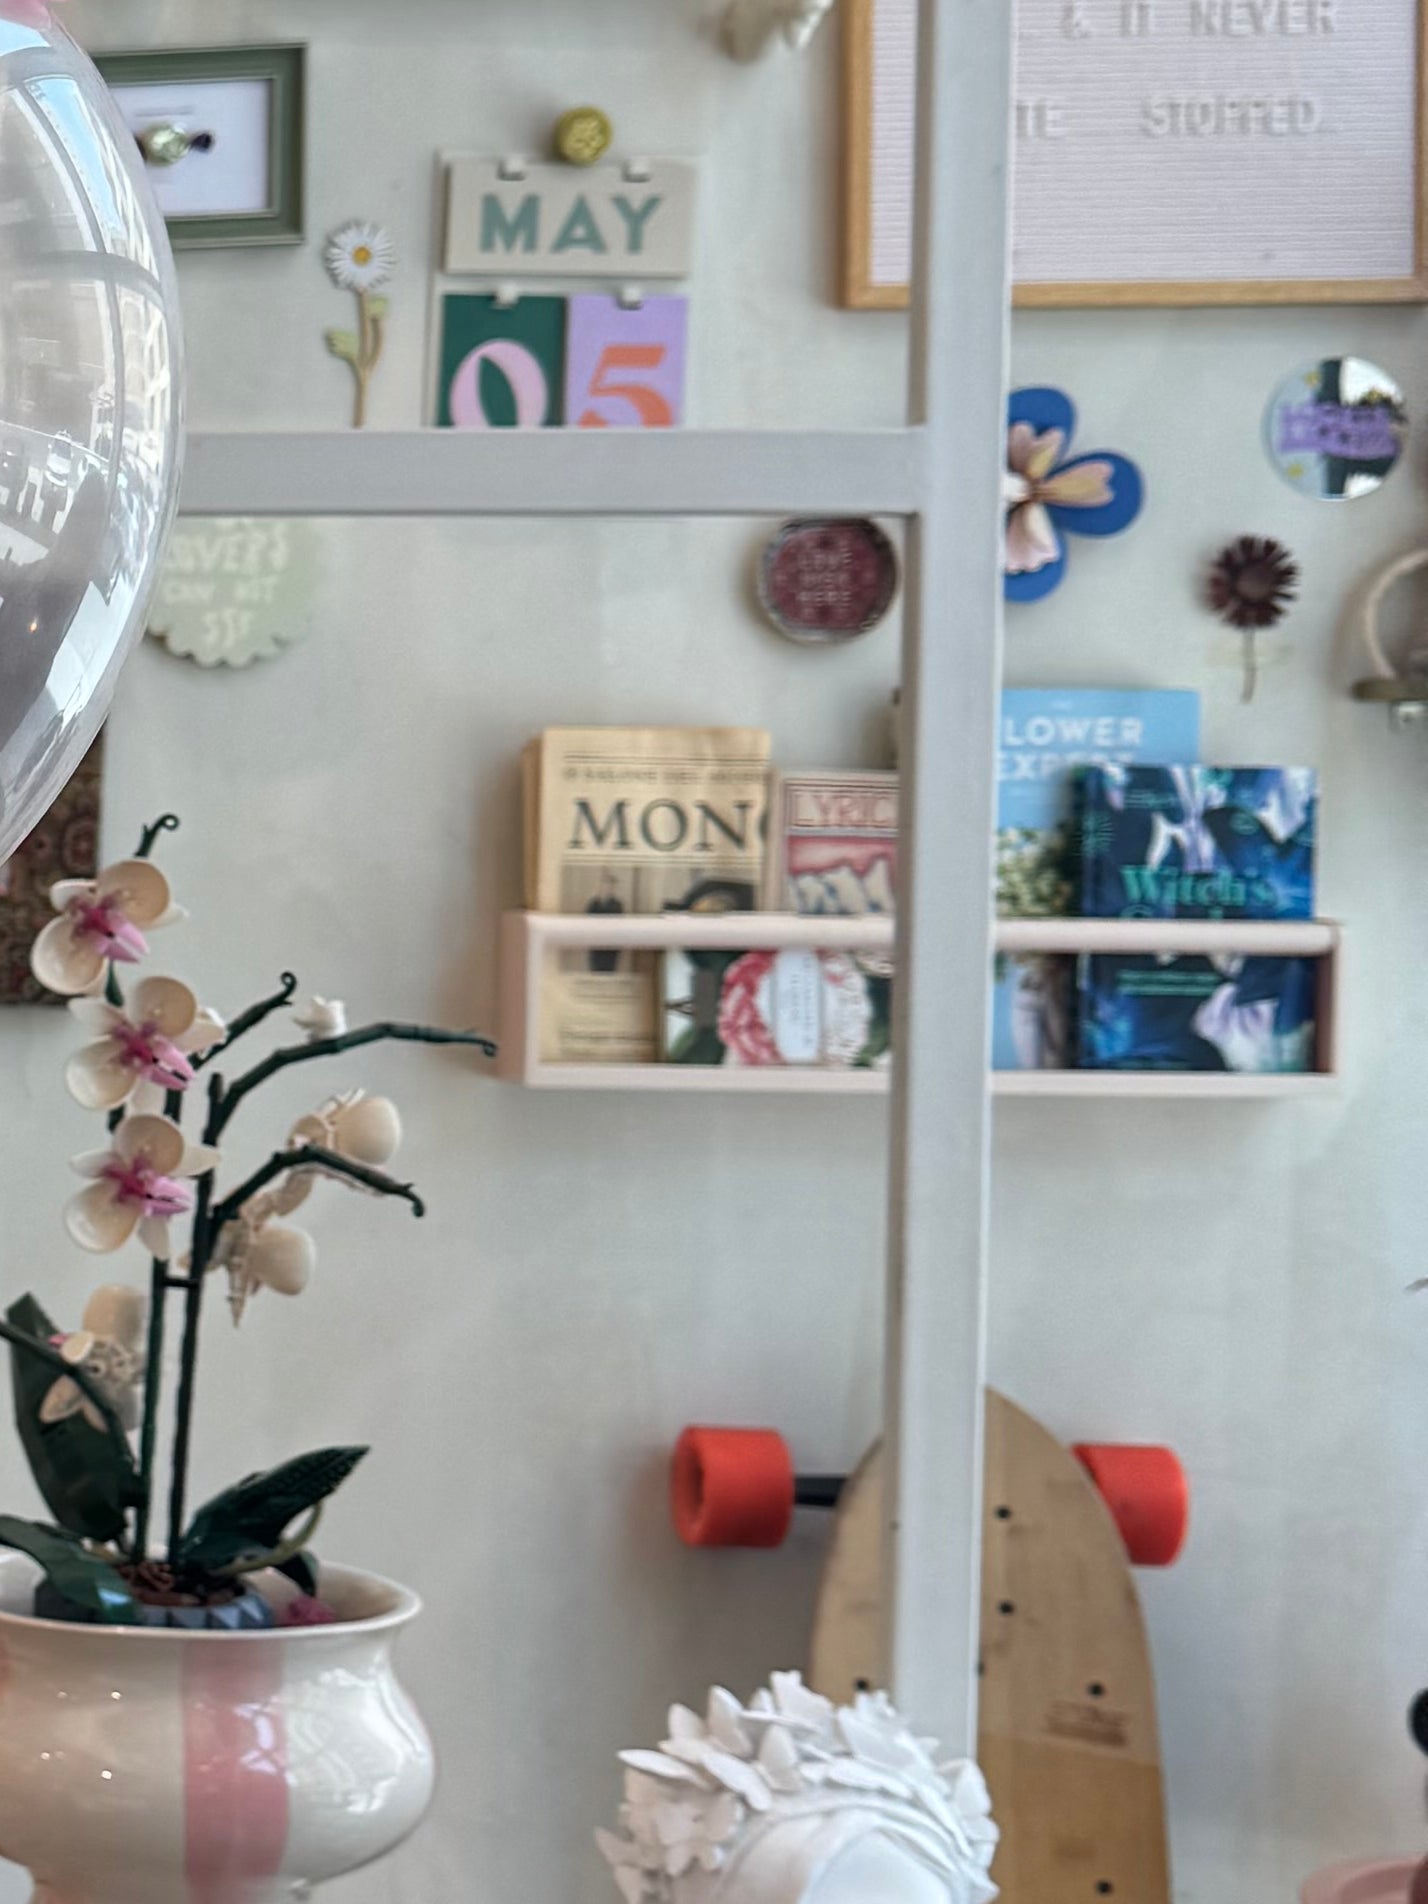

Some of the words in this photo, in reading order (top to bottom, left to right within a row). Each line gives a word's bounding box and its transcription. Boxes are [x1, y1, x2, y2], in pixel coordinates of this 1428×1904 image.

[1142, 93, 1323, 137] STOPPED
[479, 192, 665, 255] MAY
[1002, 716, 1142, 746] LOWER
